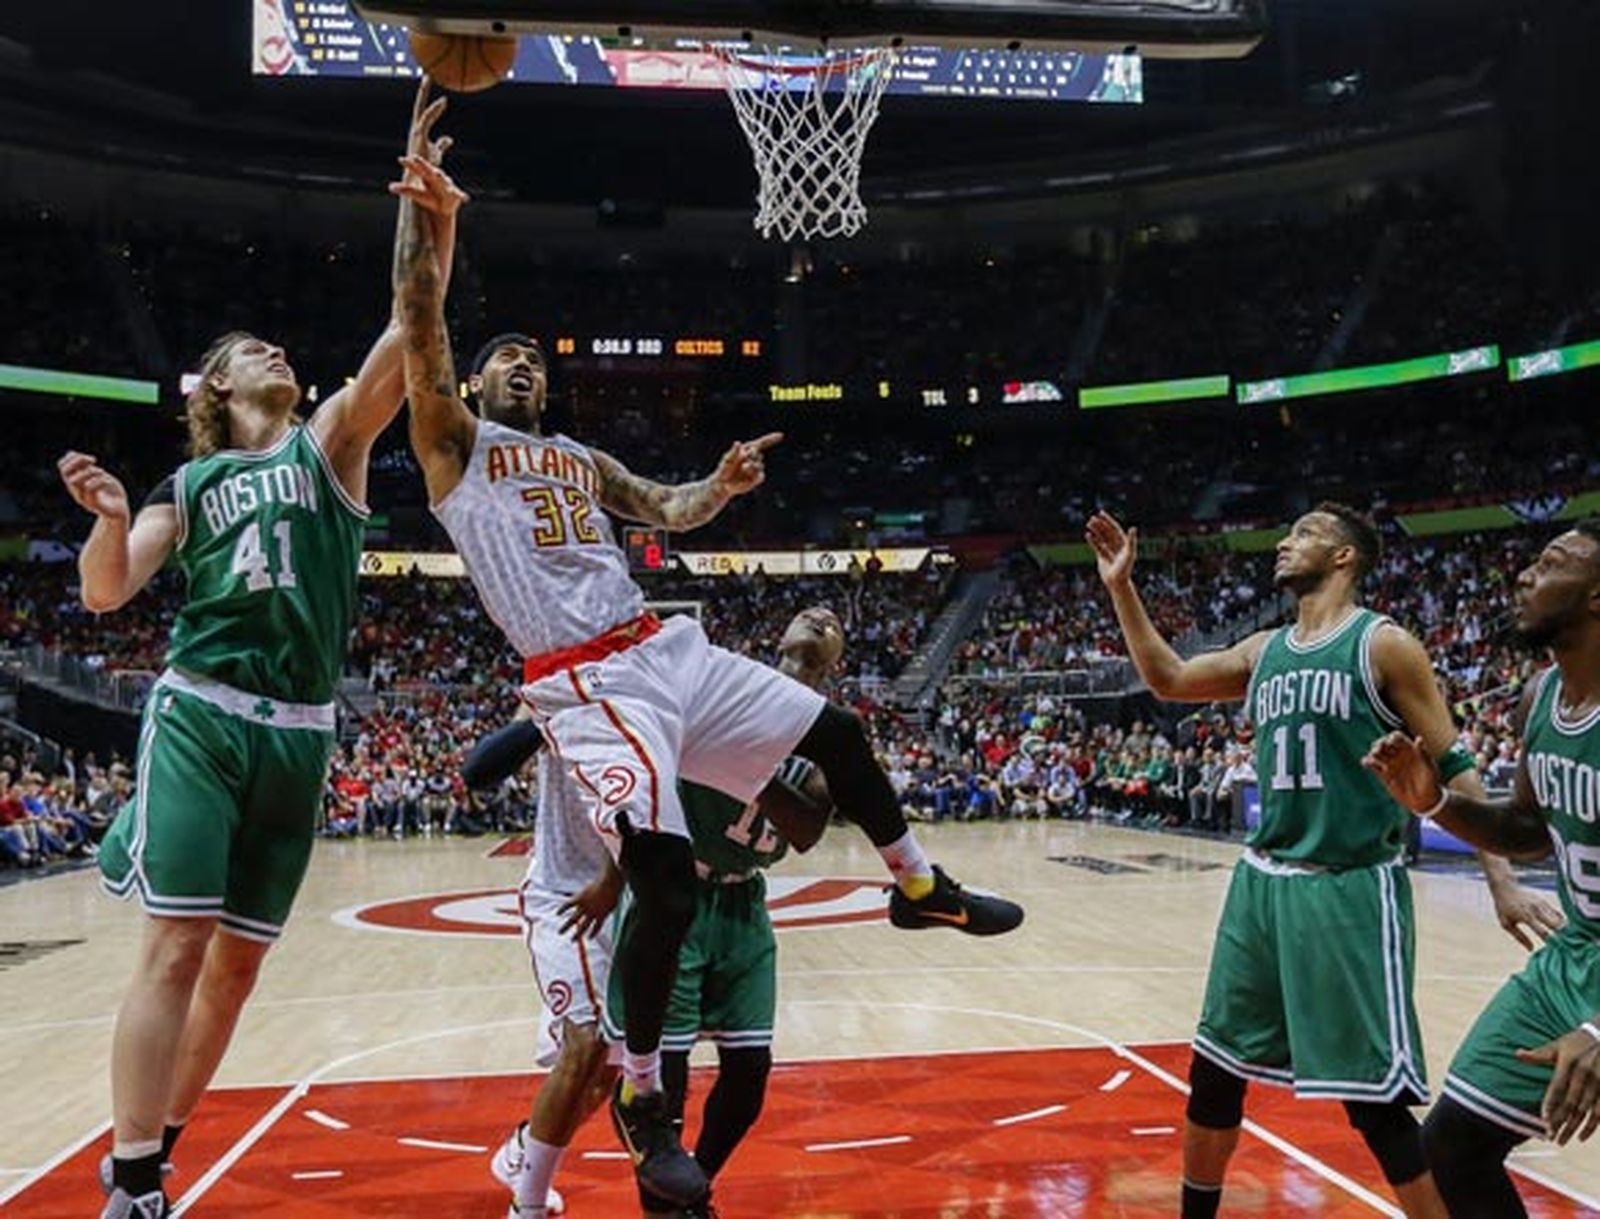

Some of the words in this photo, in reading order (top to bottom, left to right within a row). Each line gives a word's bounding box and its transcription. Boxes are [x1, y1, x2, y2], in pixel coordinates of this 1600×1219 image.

[675, 340, 724, 355] CELTICS
[768, 385, 805, 401] Team
[806, 383, 842, 399] Fouls
[202, 464, 317, 536] BOSTON
[486, 444, 600, 498] ATLANT
[521, 486, 601, 547] 32
[232, 520, 297, 591] 41
[1257, 668, 1352, 726] BOSTON
[1271, 722, 1324, 790] 11
[1528, 752, 1600, 823] OSTO
